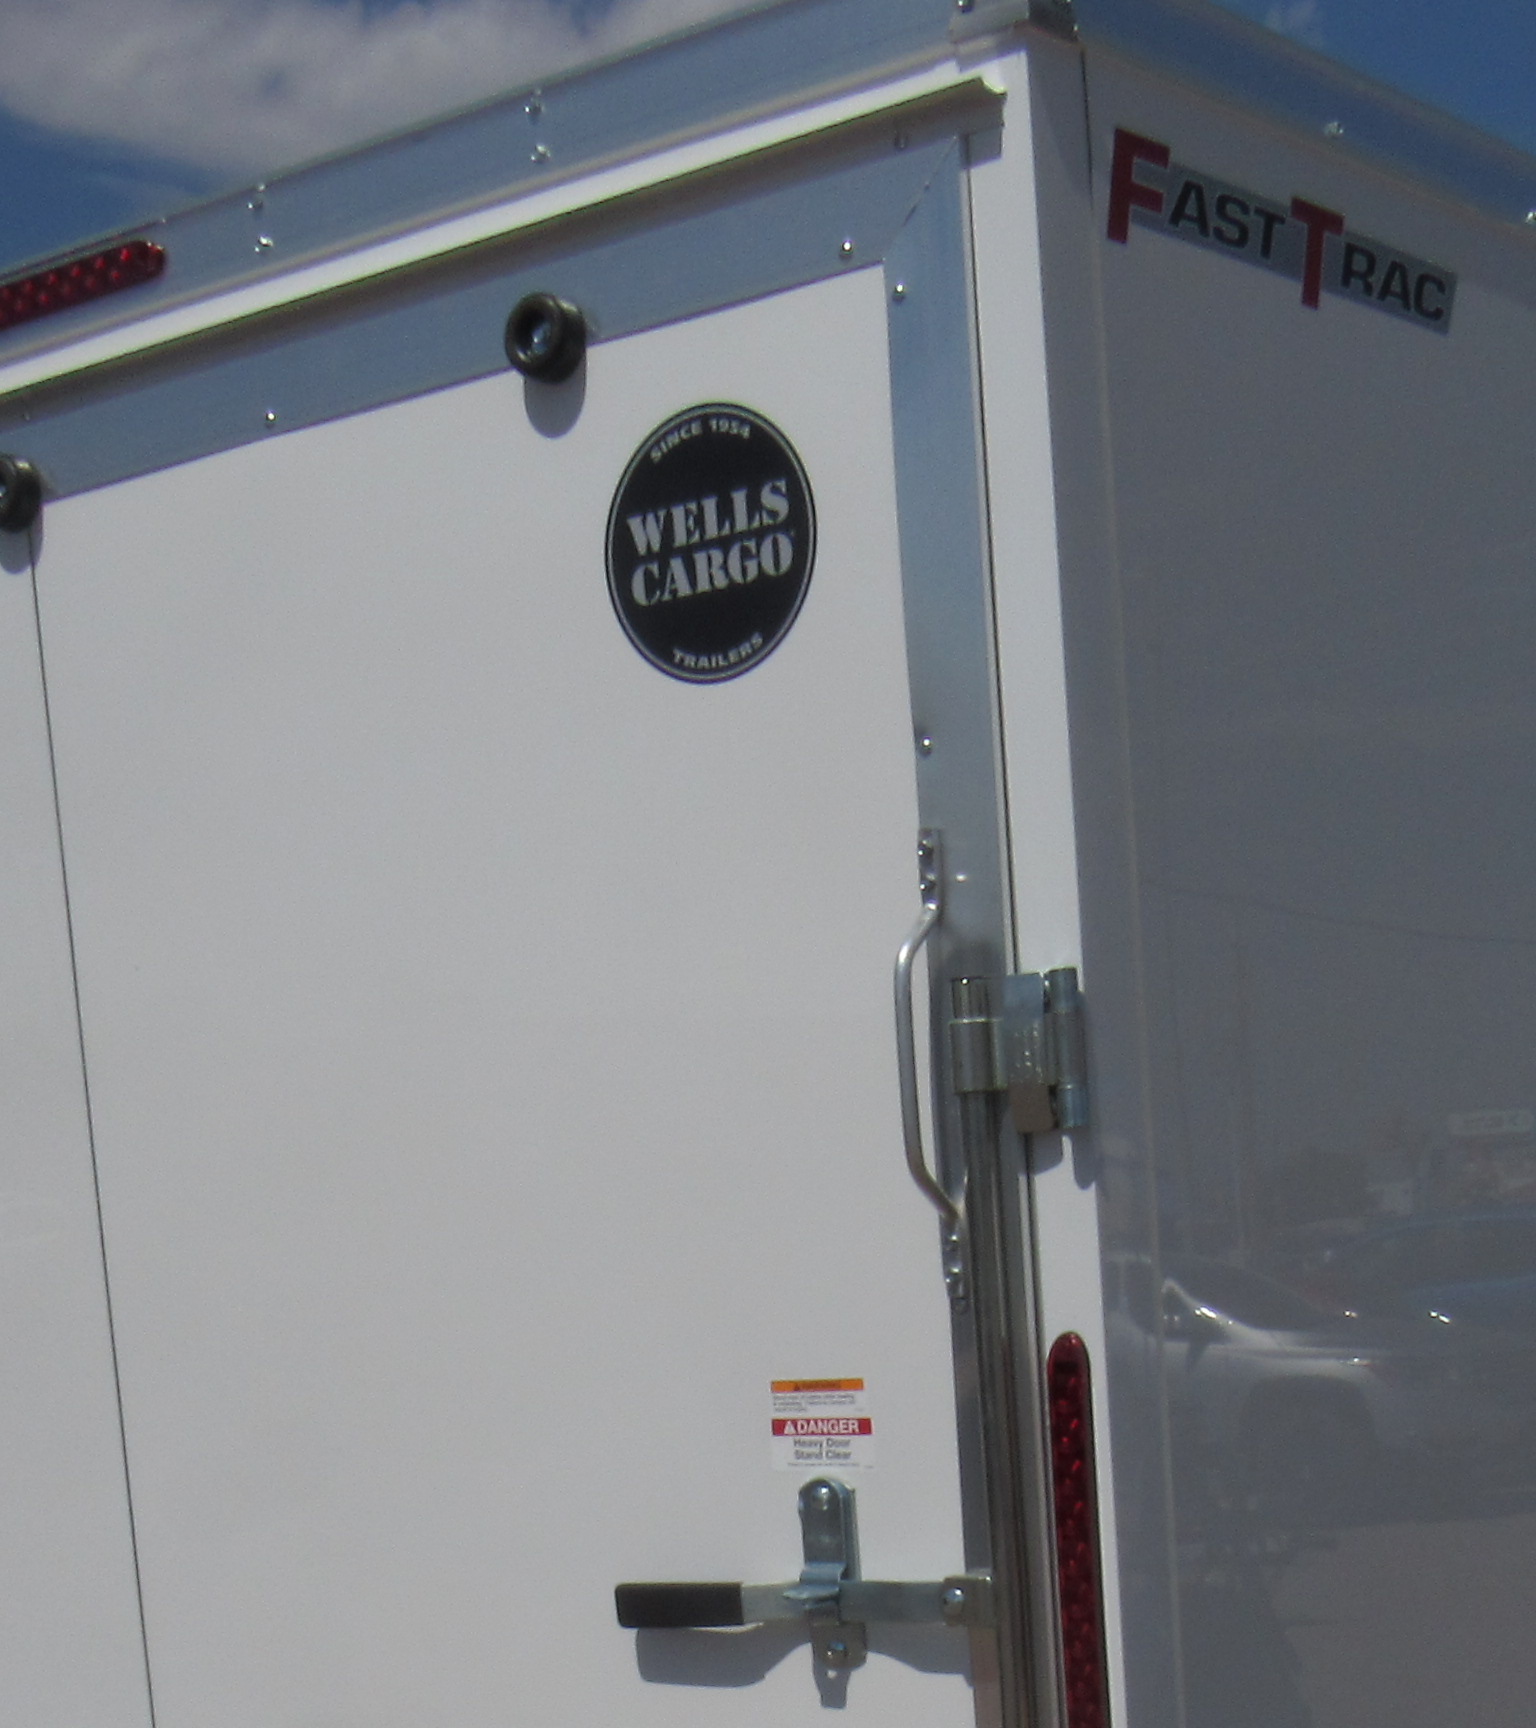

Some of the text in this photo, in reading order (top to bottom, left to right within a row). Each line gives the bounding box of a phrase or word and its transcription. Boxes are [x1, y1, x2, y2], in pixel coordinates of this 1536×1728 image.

[1106, 126, 1447, 323] FAST TRAC
[649, 419, 703, 464] SINCE
[626, 478, 790, 557] WELLS
[630, 531, 794, 607] CARGO
[672, 632, 763, 669] TRAILERS
[793, 1438, 851, 1450] Heavy Door
[796, 1419, 860, 1434] DANGER
[794, 1449, 852, 1460] Stand Clear
